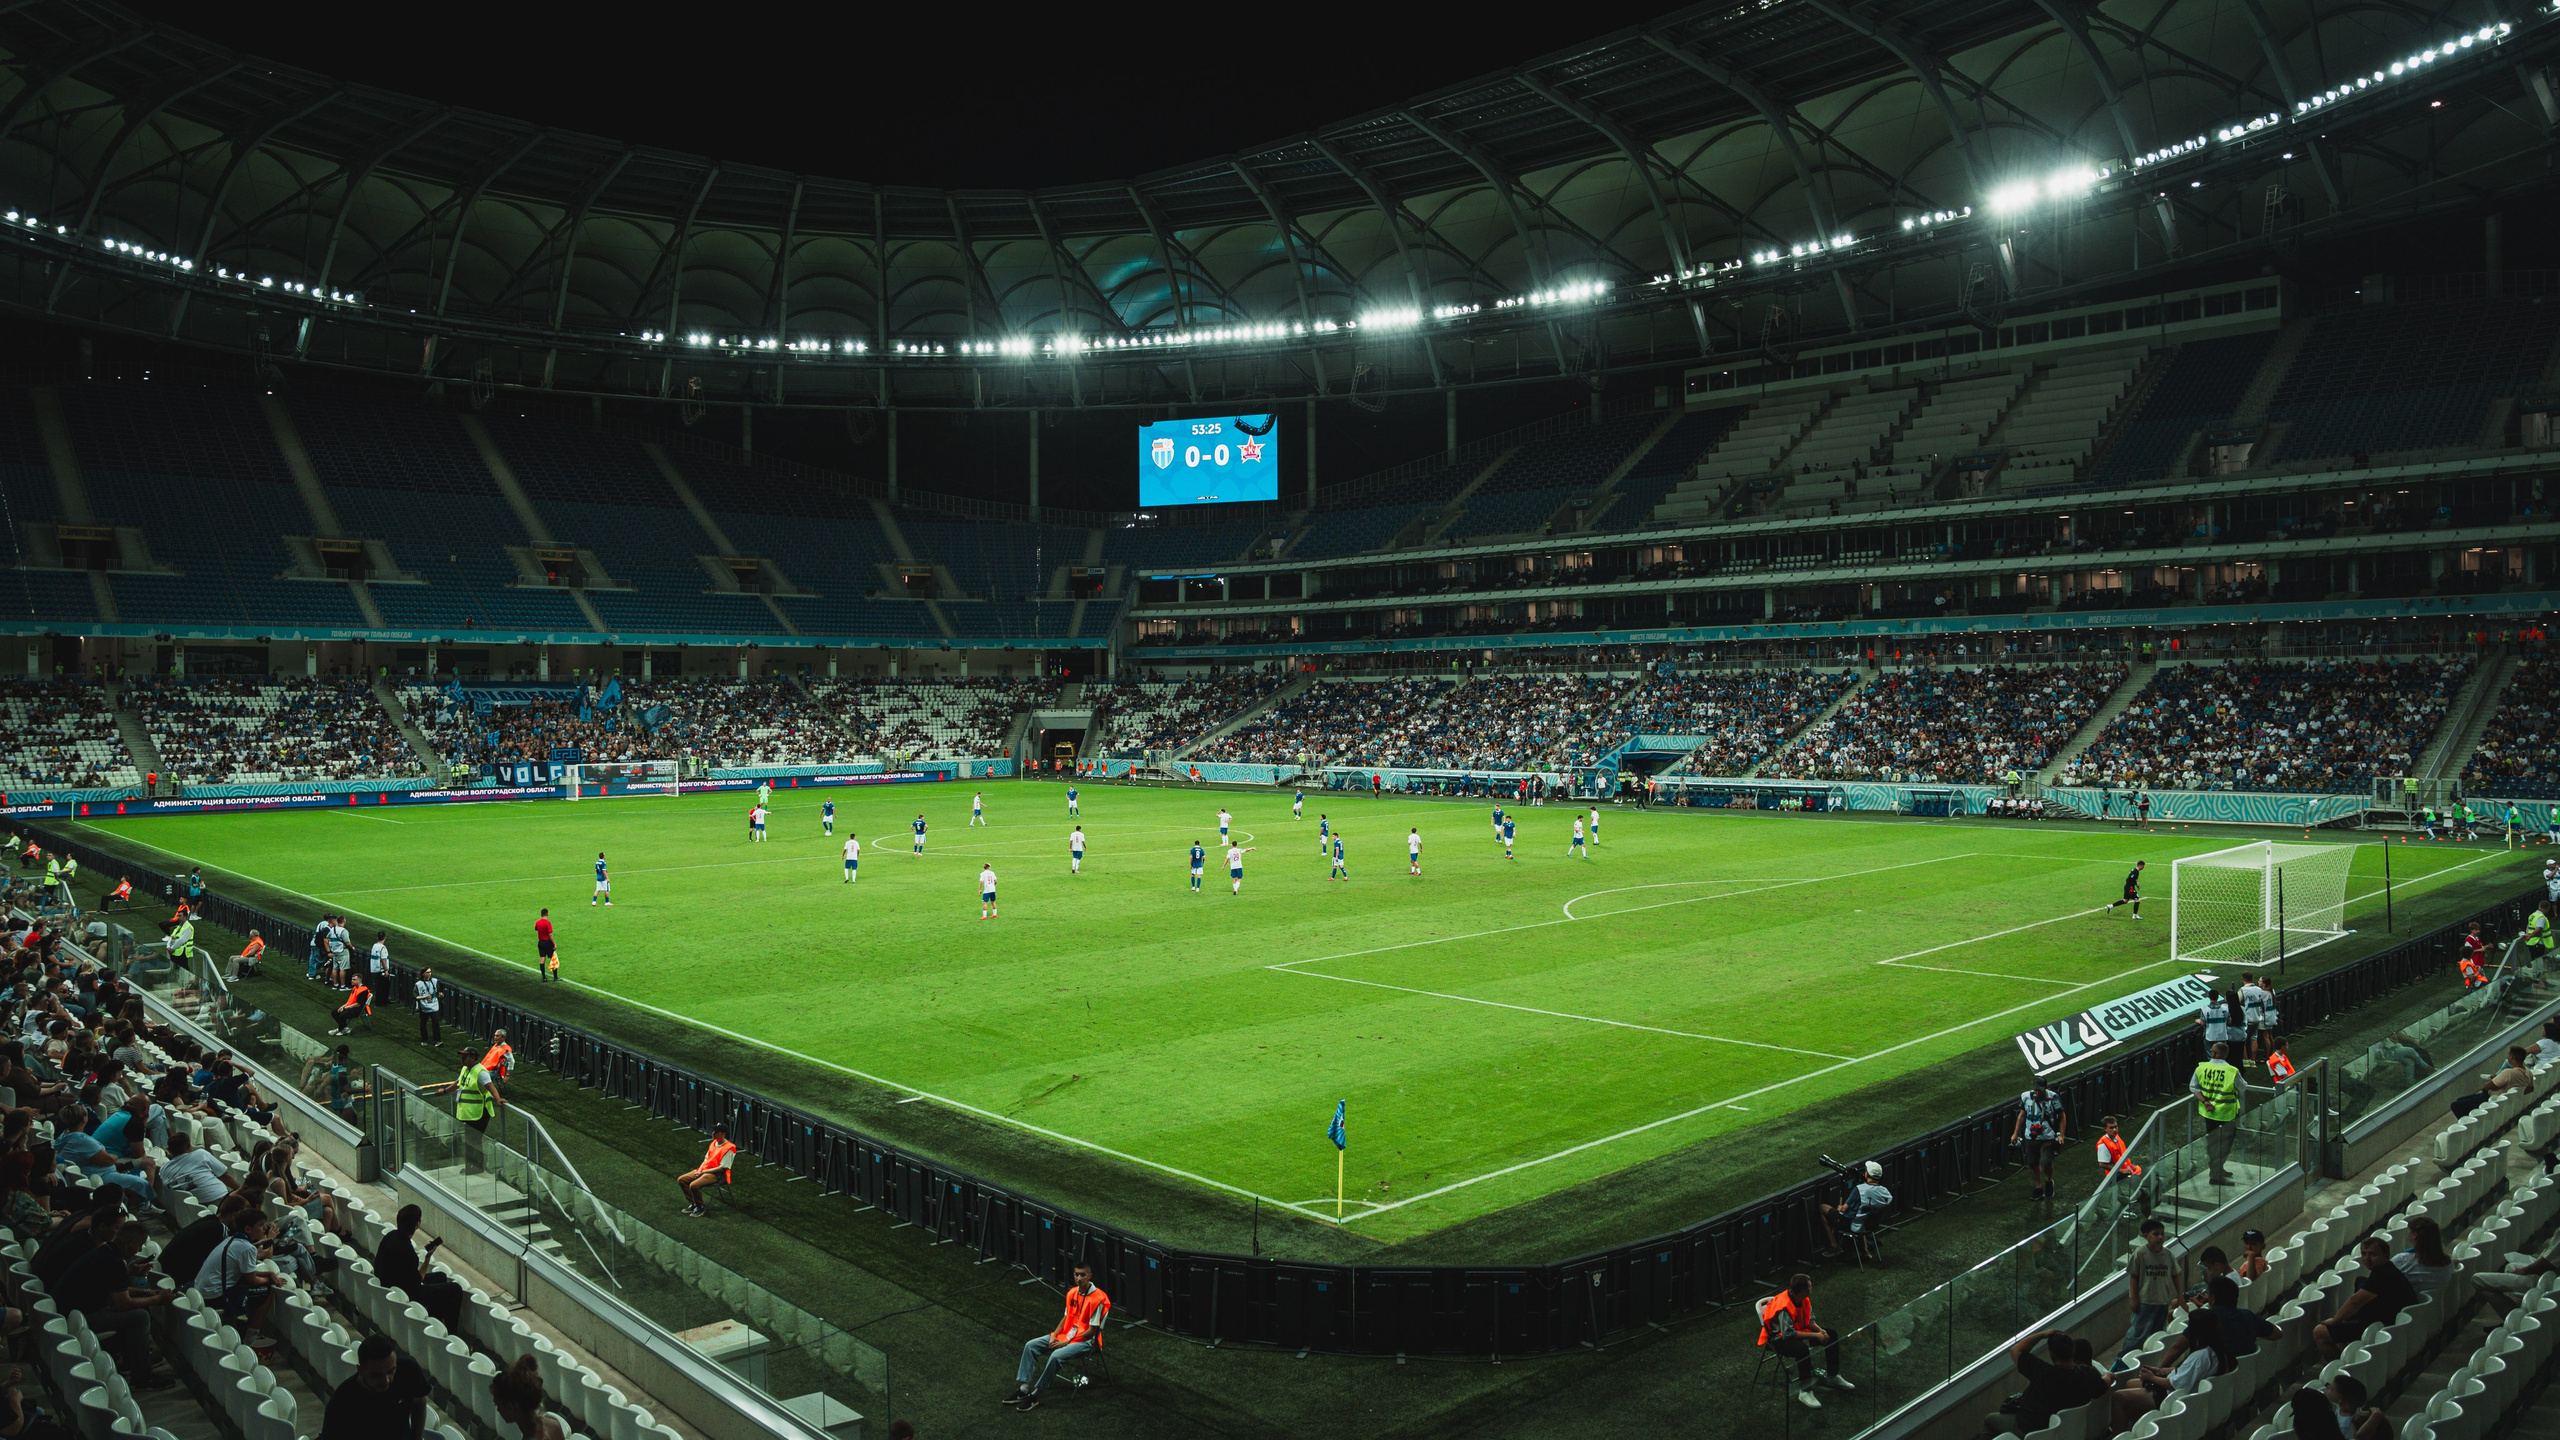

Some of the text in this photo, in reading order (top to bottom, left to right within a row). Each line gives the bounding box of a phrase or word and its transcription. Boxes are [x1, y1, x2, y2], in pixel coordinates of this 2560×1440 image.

[1192, 423, 1222, 435] 53:25
[2088, 615, 2111, 623] ВПЕРЕД
[679, 780, 726, 788] ВОЛГОГРАДСКОЙ
[410, 790, 469, 798] АДМИНИСТРАЦИЯ
[470, 787, 525, 796] ВОЛГОГРАДСКОЙ
[153, 799, 224, 808] АДМИНИСТРАЦИЯ
[225, 796, 290, 805] ВОЛГОГРАДСКОЙ
[1195, 850, 1201, 859] 8
[2103, 980, 2209, 1031] БУКМЕКЕР
[2203, 1068, 2225, 1081] 14175
